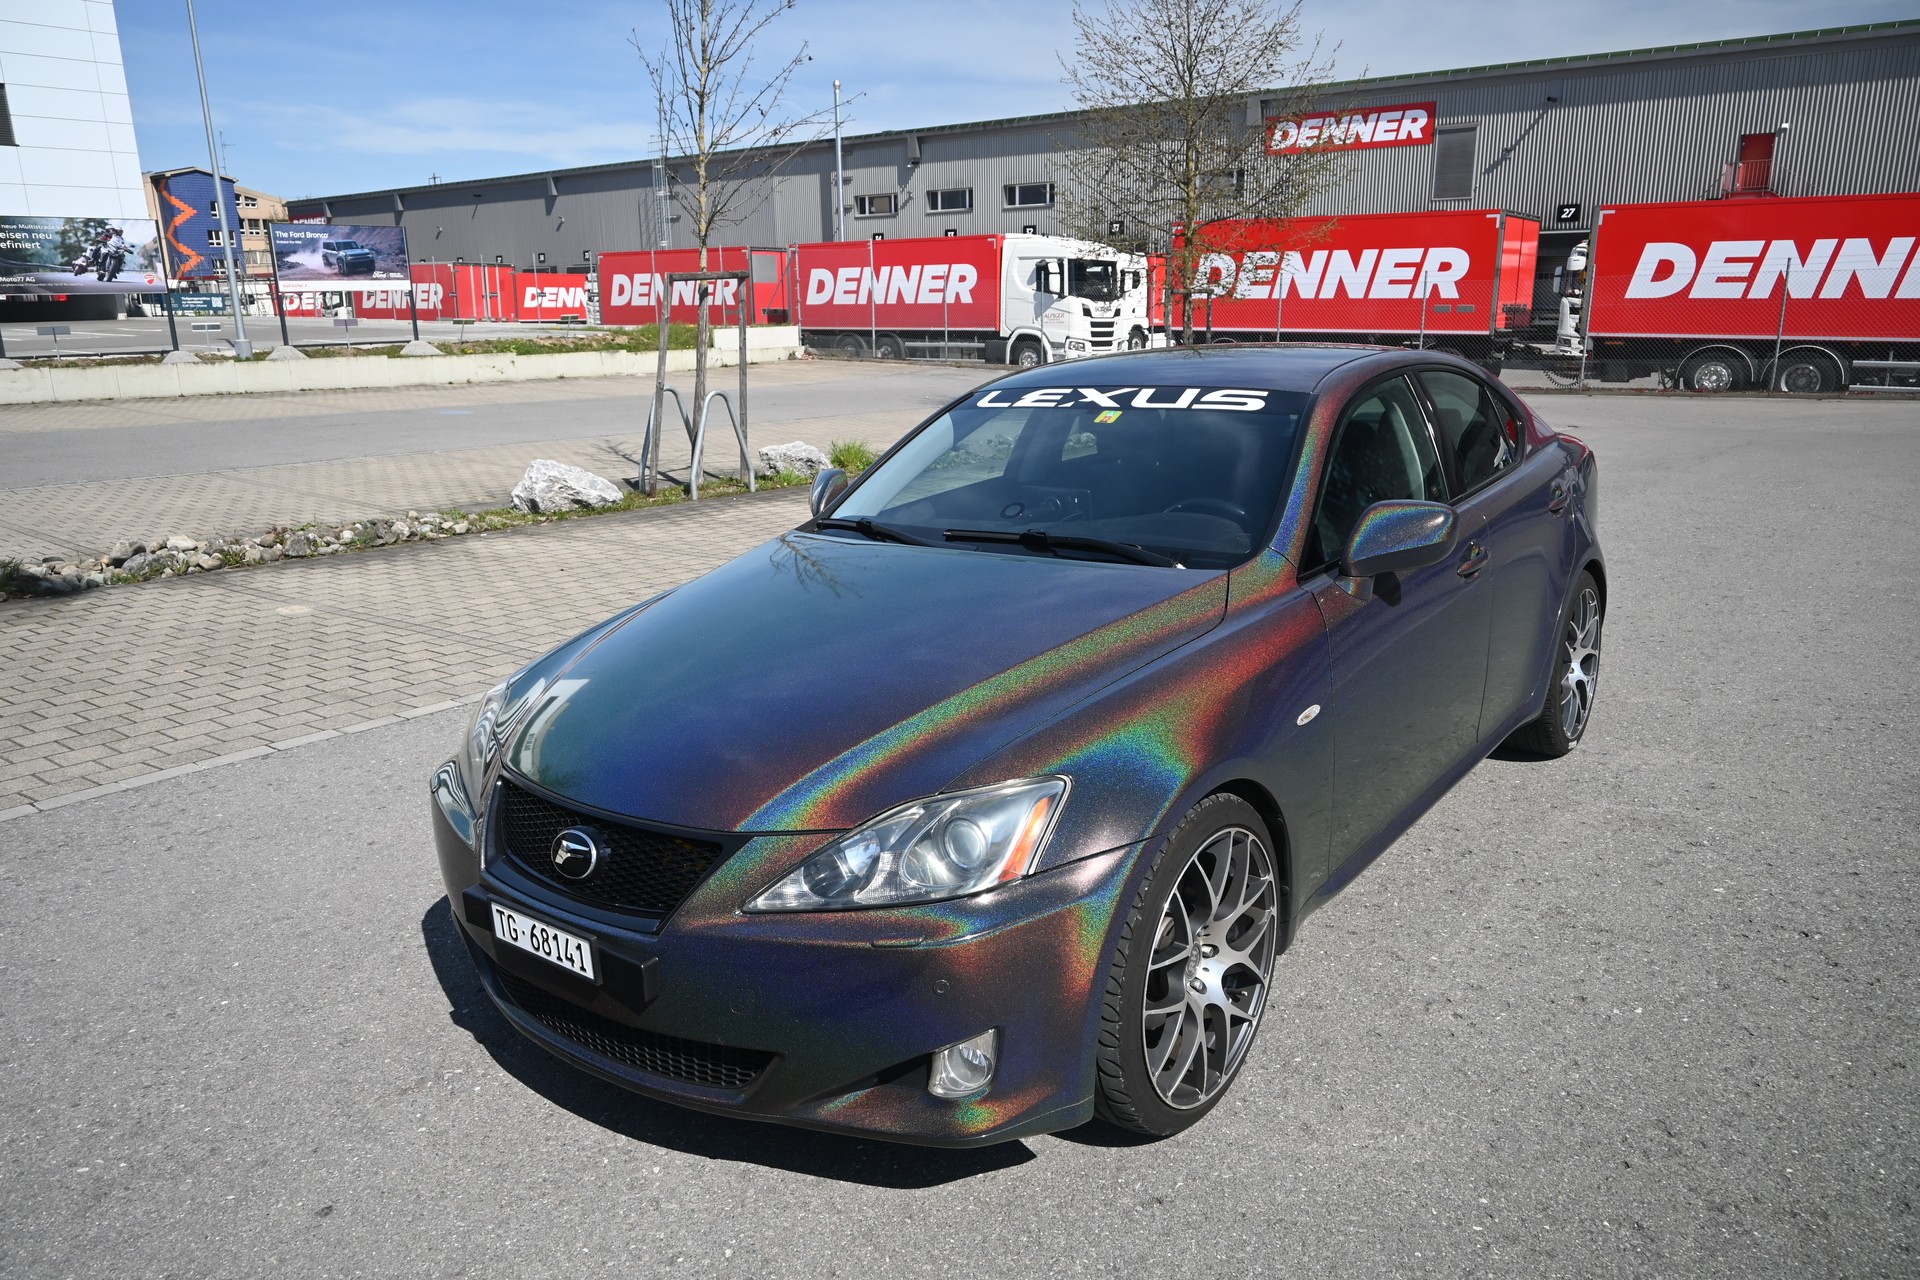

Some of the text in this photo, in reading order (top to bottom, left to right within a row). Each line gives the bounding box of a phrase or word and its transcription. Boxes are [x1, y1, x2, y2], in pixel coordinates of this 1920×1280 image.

[1270, 109, 1428, 150] DENNER
[1560, 207, 1575, 218] 27
[0, 231, 52, 240] eisen neu
[0, 240, 41, 249] efiniert
[275, 230, 288, 238] The
[1191, 247, 1470, 299] DENNER
[1624, 237, 1920, 299] DENN
[610, 273, 738, 306] DENNER
[806, 263, 978, 305] DENNER
[524, 287, 588, 308] DENN
[976, 388, 1269, 411] LEXUS
